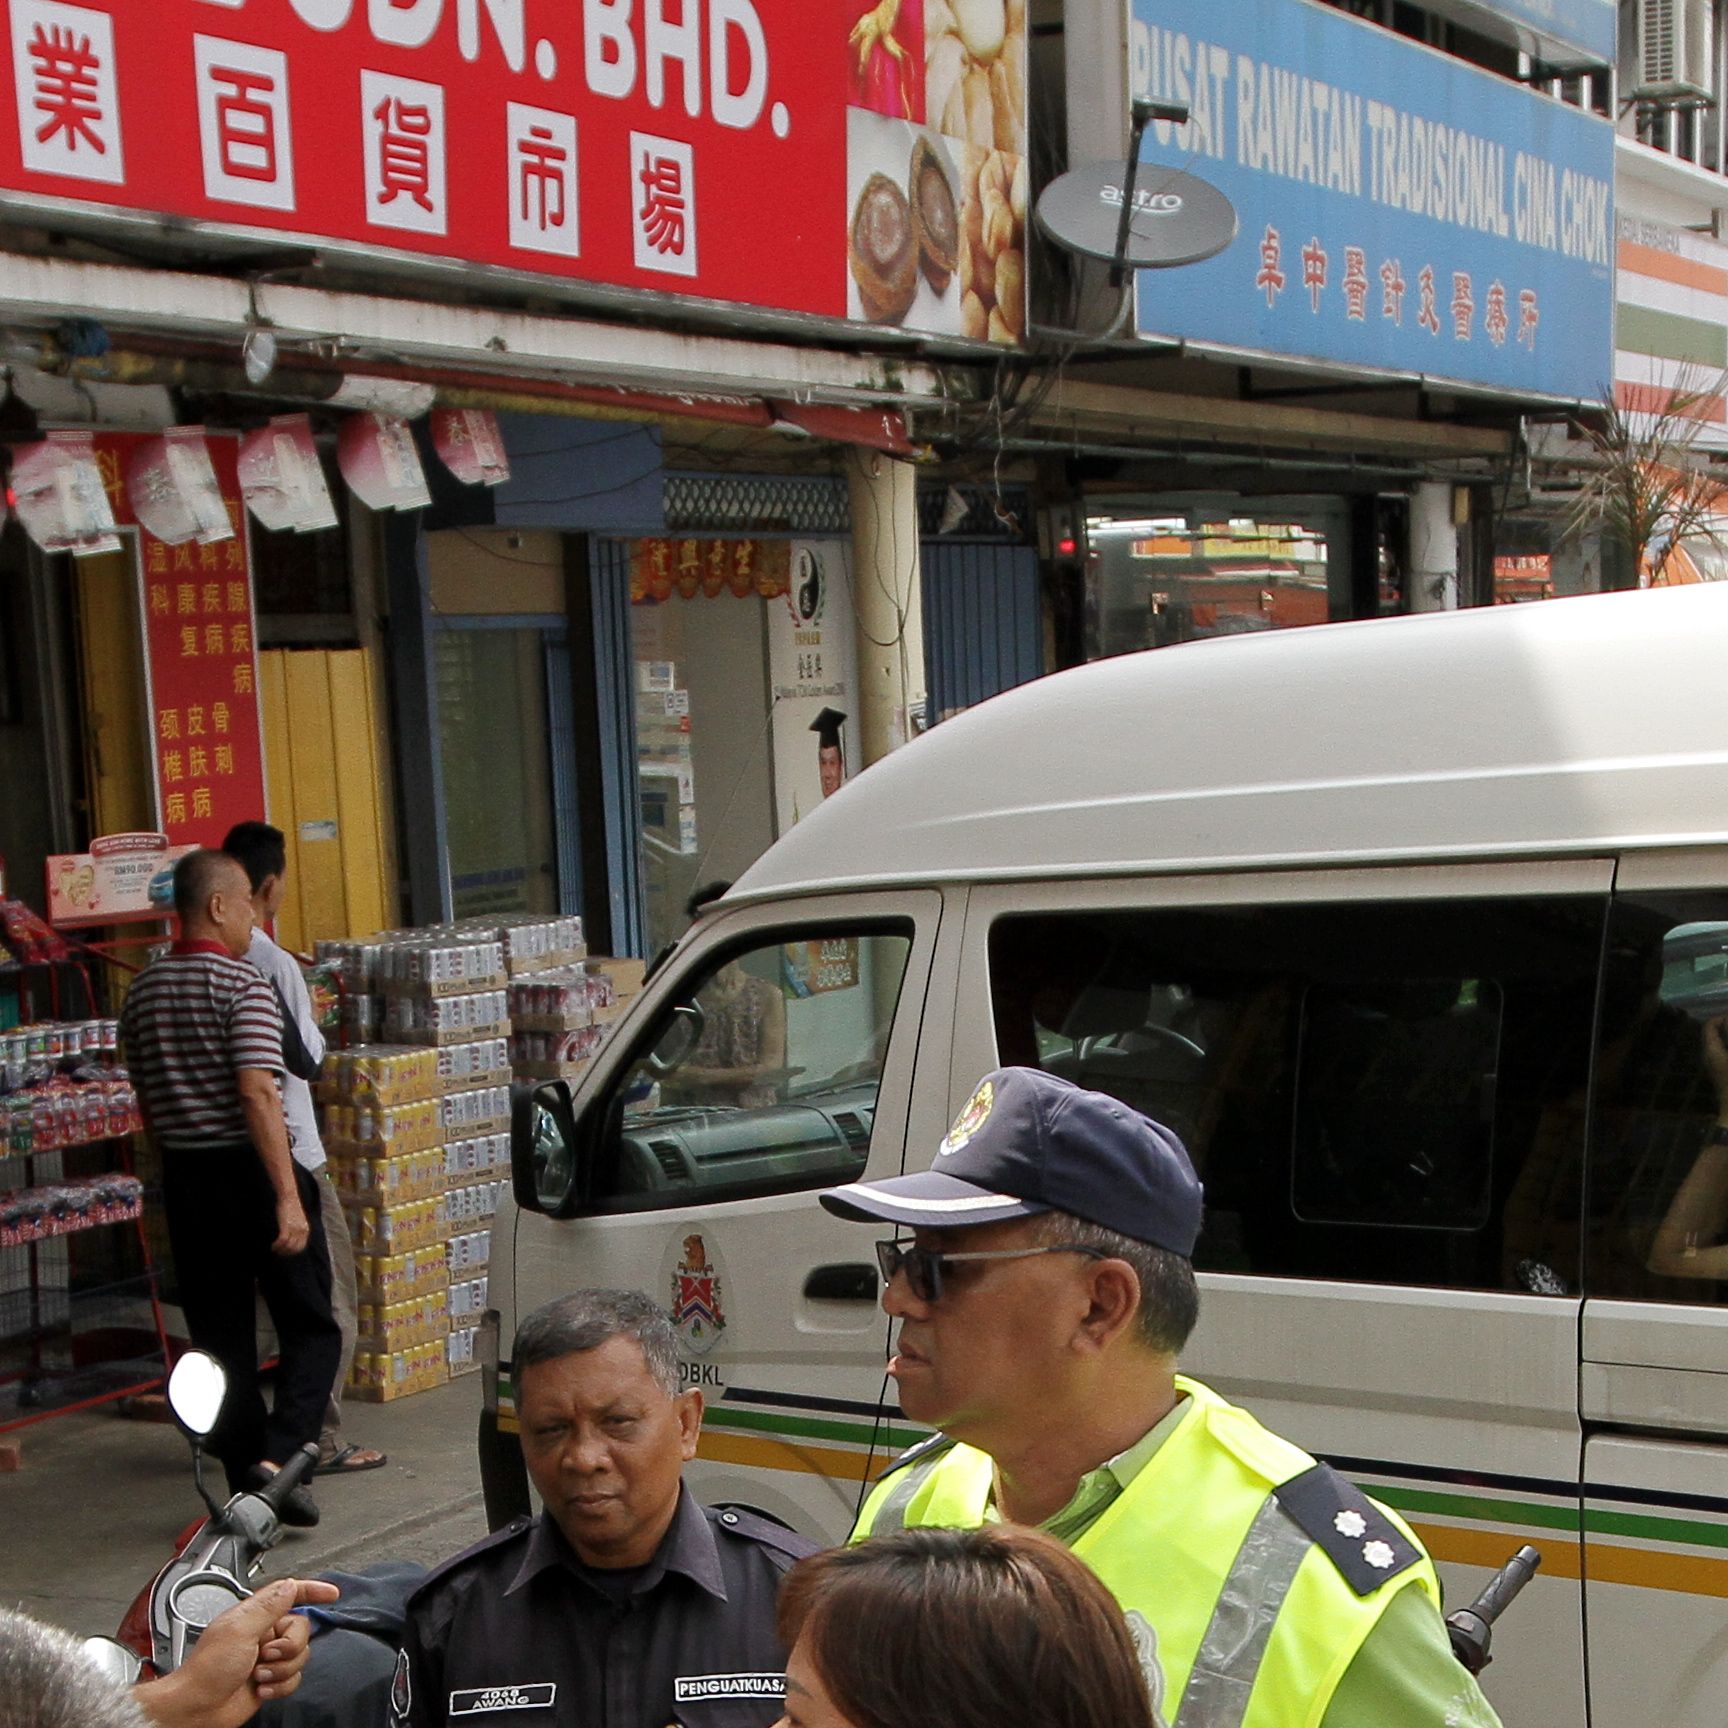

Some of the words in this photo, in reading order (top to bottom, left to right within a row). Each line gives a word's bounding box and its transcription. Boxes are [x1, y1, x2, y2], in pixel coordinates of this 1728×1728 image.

[584, 0, 790, 138] BHD.
[1131, 18, 1229, 160] PUSAT
[1237, 54, 1361, 197] RAWATAN
[1367, 98, 1510, 240] TRADISIONAL
[1514, 149, 1558, 251] CINA
[1561, 167, 1608, 266] CHOK
[187, 705, 213, 818] 皮肤病
[211, 701, 235, 775] 骨刺
[680, 1362, 724, 1386] DBKL
[472, 1695, 530, 1710] AWANG
